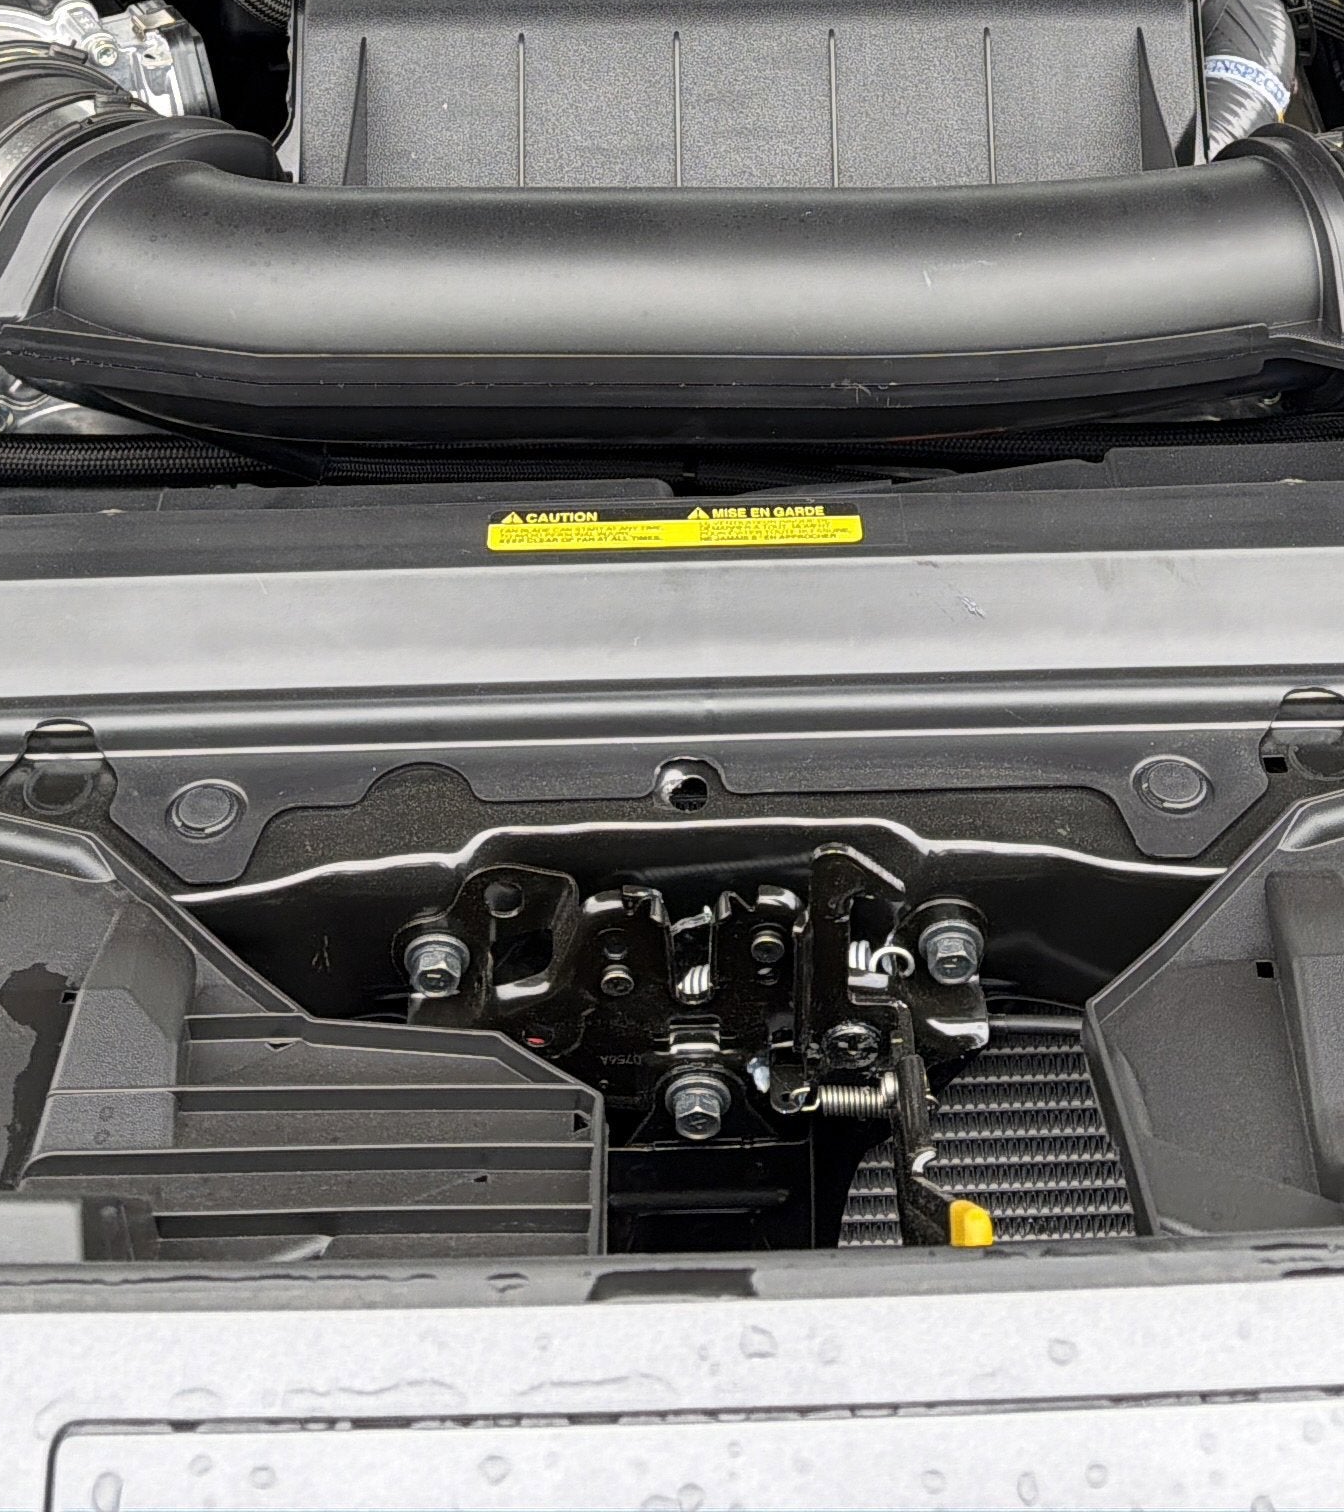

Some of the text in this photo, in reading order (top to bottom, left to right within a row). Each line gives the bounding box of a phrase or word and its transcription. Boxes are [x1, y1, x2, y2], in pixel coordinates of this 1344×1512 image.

[525, 511, 598, 524] CAUTION
[711, 505, 825, 519] MISE EN GARDE
